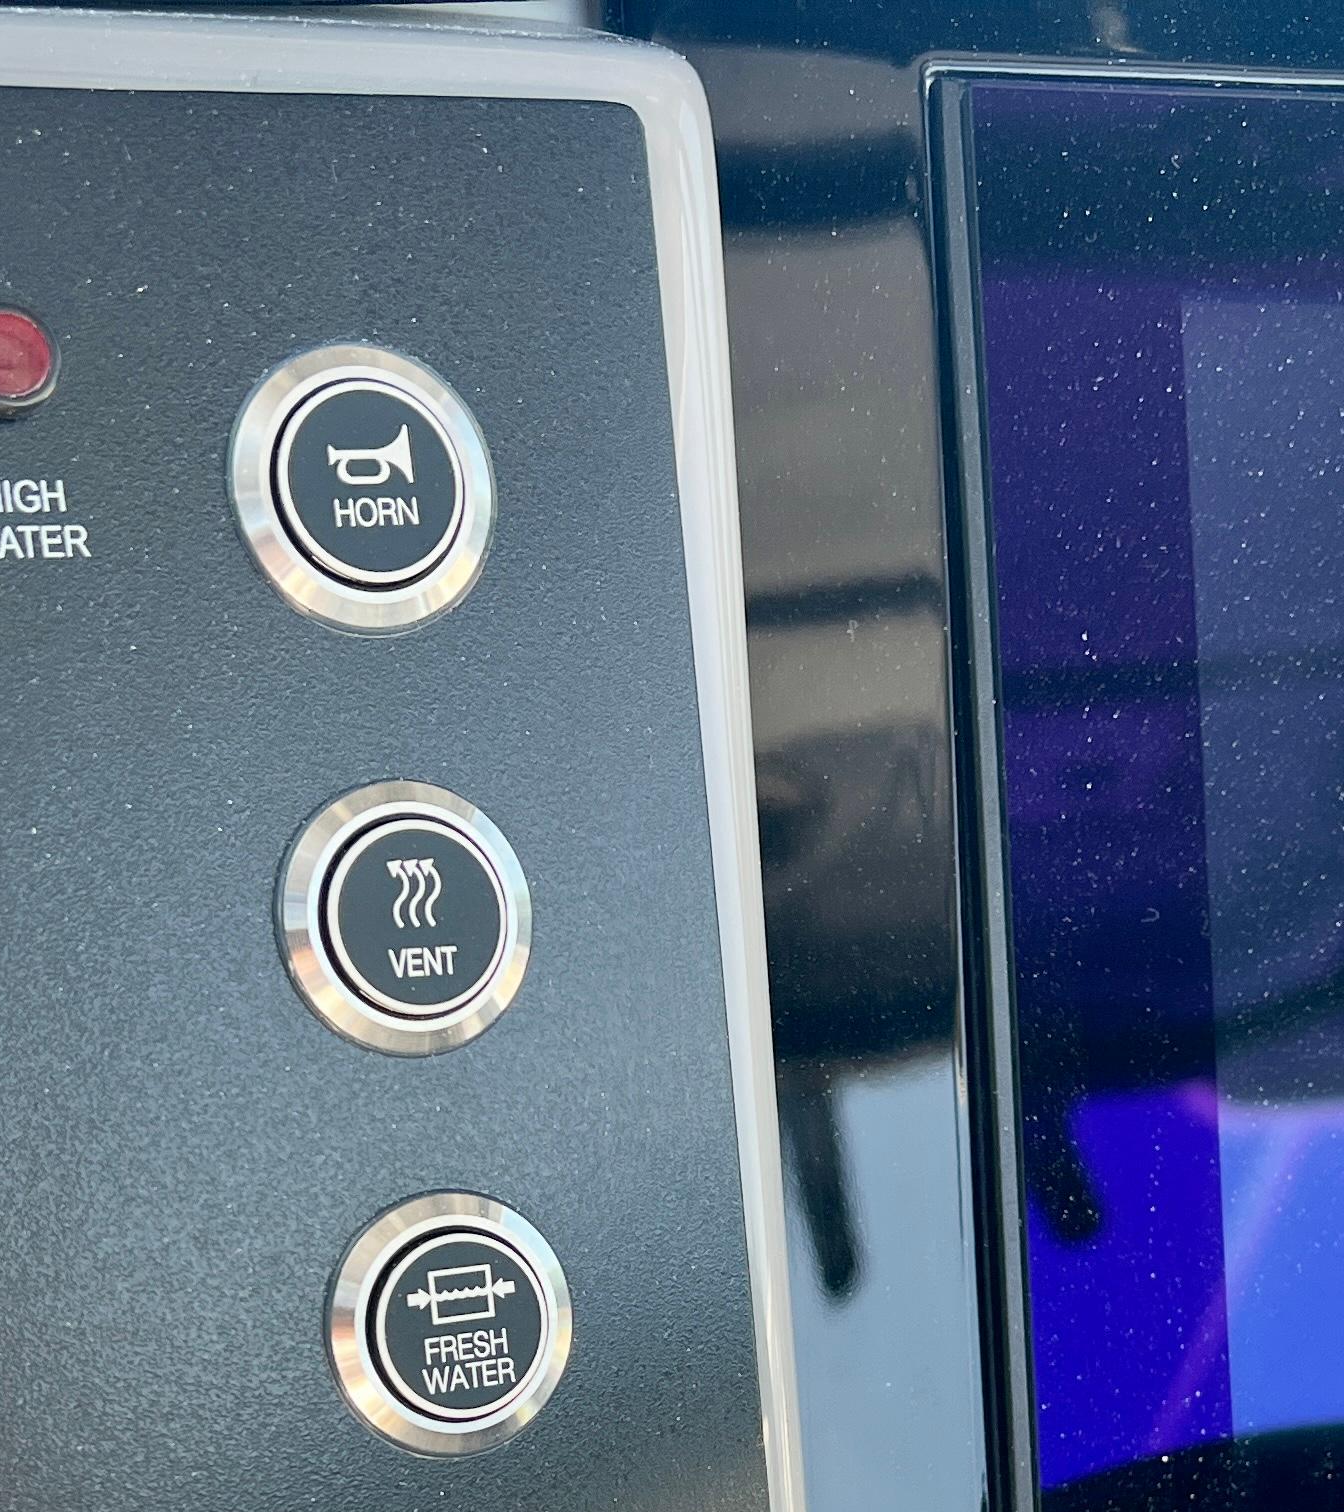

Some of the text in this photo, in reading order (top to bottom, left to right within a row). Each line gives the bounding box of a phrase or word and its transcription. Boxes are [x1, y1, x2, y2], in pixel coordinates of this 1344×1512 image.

[333, 496, 420, 528] HORN
[387, 945, 458, 978] VENT
[423, 1327, 509, 1365] FRESH
[421, 1357, 516, 1395] WATER
